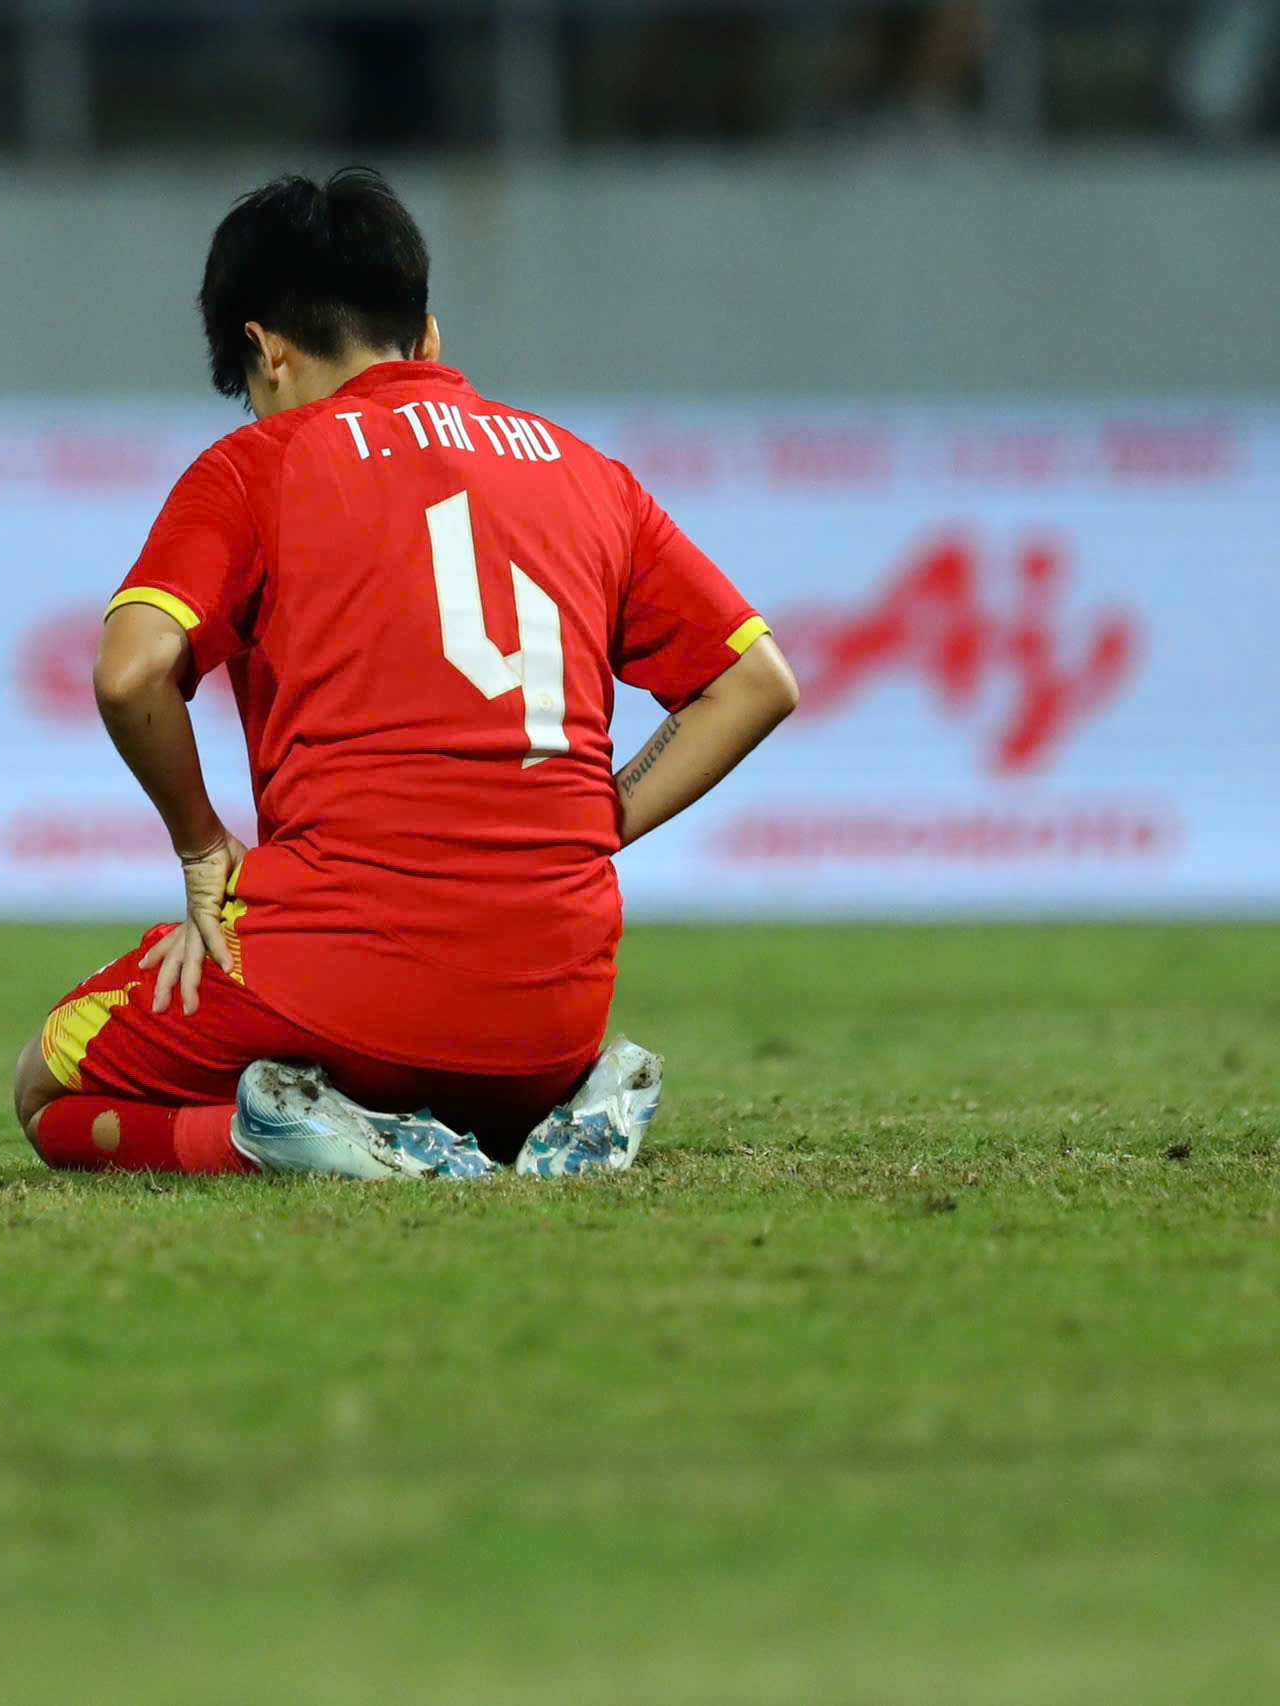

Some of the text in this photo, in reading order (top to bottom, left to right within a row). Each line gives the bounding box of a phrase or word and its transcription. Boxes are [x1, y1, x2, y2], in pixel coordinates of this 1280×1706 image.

[335, 411, 392, 460] T.
[393, 401, 476, 453] THI
[468, 413, 562, 463] THU
[425, 490, 570, 770] 4
